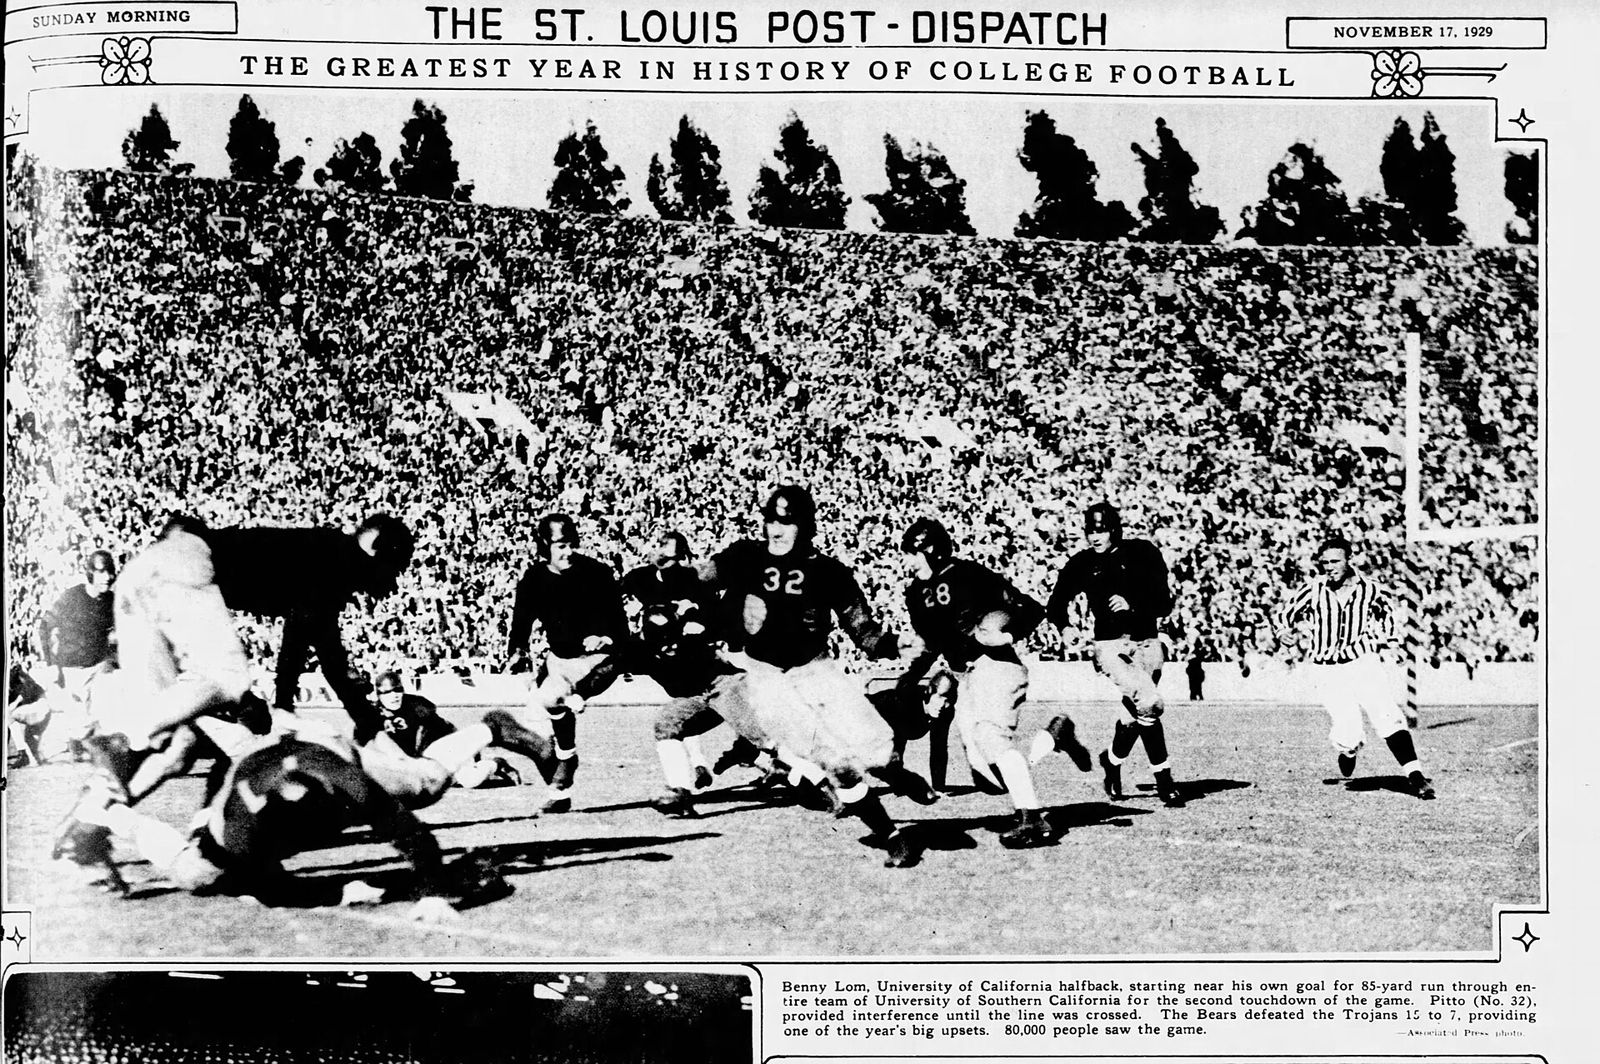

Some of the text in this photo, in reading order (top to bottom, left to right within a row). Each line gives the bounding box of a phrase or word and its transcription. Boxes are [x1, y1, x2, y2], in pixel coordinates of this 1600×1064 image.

[33, 11, 190, 28] SUNDAY MORNING
[425, 6, 502, 40] THE
[535, 9, 593, 41] ST.
[621, 10, 737, 44] LOUIS
[1334, 26, 1492, 38] NOVEMBER 17, 1929
[240, 56, 1294, 86] THE GREATEST YEAR IN HISTORY OF COLLEGE FOOTBALL
[764, 567, 804, 595] 32
[922, 583, 951, 608] 28
[782, 981, 827, 994] Benny
[835, 981, 870, 993] Lom,
[877, 981, 952, 994] University
[959, 980, 973, 991] of
[981, 980, 1052, 991] California
[1059, 980, 1122, 992] halfback,
[1130, 980, 1185, 994] starting
[1194, 983, 1224, 991] near
[1232, 980, 1252, 991] his
[1260, 983, 1288, 991] own
[1297, 981, 1325, 994] goal
[1334, 980, 1354, 991] for
[1362, 981, 1412, 993] 85-yard
[1452, 981, 1507, 994] through
[1516, 984, 1536, 992] en-
[784, 994, 1536, 1008] tire team of University of Southern California for the second touchdown of the game. Pitto (No. 32),
[783, 1010, 844, 1024] provided
[853, 1010, 938, 1020] interference
[947, 1009, 979, 1020] until
[989, 1010, 1010, 1020] the
[1018, 1009, 1044, 1020] line
[1052, 1012, 1078, 1020] was
[1086, 1009, 1142, 1020] crossed.
[1161, 1009, 1188, 1020] The
[1197, 1009, 1236, 1019] Bears
[1245, 1009, 1304, 1020] defeated
[1313, 1009, 1334, 1019] the
[1343, 1009, 1398, 1022] Trojans
[1428, 1012, 1441, 1020] to
[1451, 1010, 1460, 1021] 7,
[1469, 1010, 1536, 1023] providing
[784, 1028, 808, 1036] one
[815, 1025, 830, 1036] of
[837, 1025, 858, 1036] the
[866, 1025, 906, 1038] year's
[912, 1025, 934, 1039] big
[942, 1026, 989, 1038] upsets.
[1005, 1025, 1046, 1036] 80,000
[1053, 1024, 1098, 1038] people
[1138, 1024, 1160, 1034] the
[1167, 1027, 1206, 1037] game.
